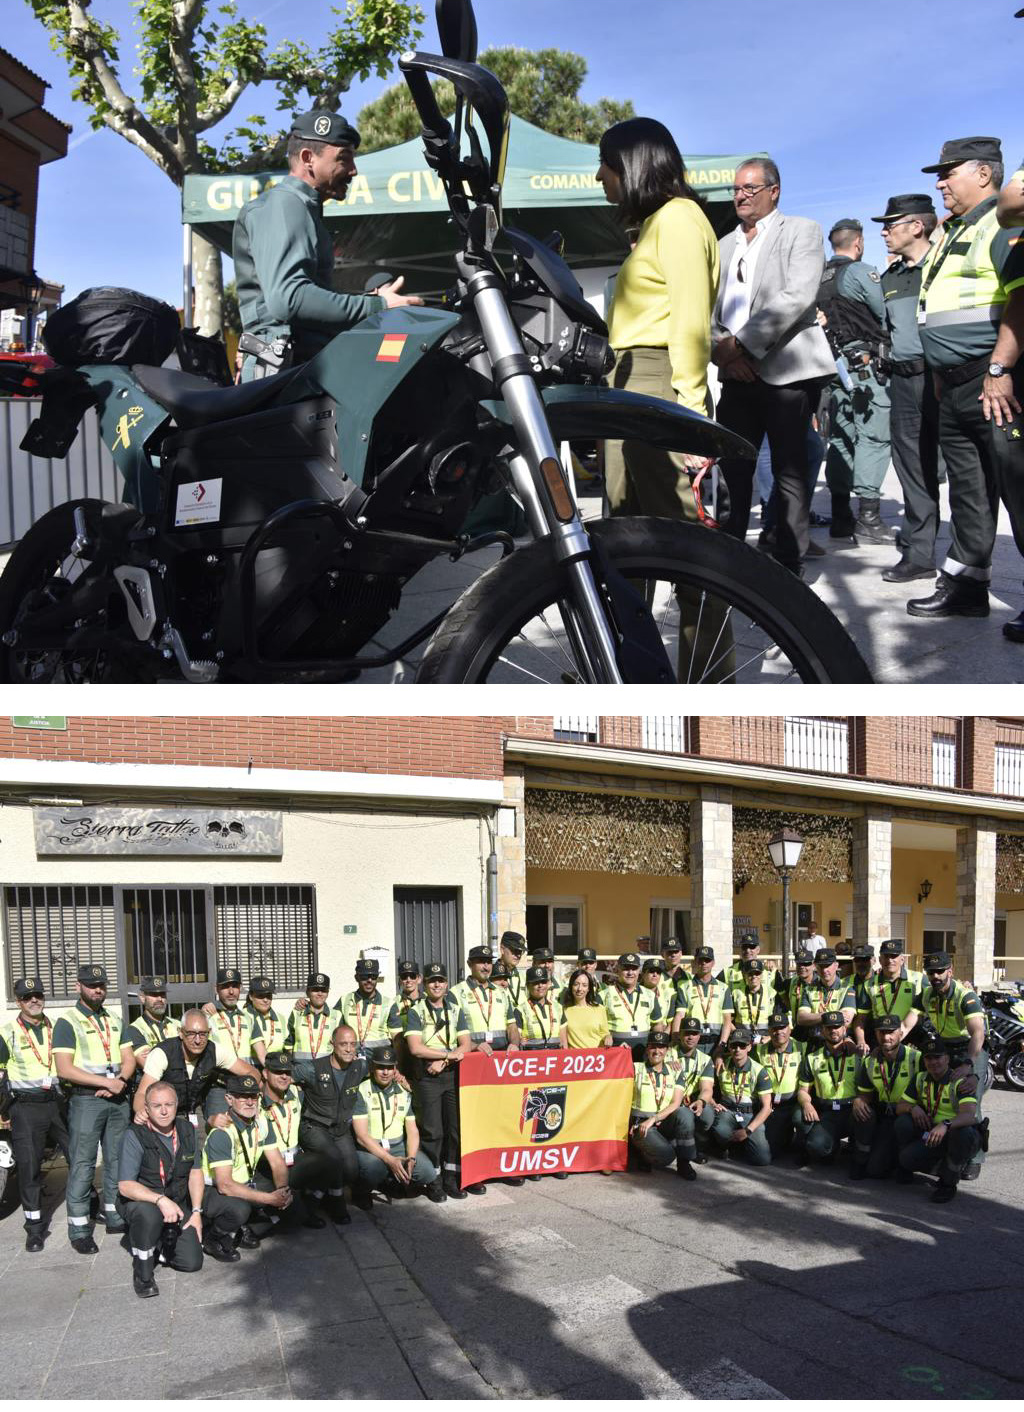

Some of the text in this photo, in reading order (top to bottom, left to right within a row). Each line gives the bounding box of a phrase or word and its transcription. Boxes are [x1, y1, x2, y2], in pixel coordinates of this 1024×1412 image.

[60, 816, 144, 838] Sierra
[494, 1055, 605, 1078] VCE-F 2023
[500, 1146, 580, 1173] UMSV
